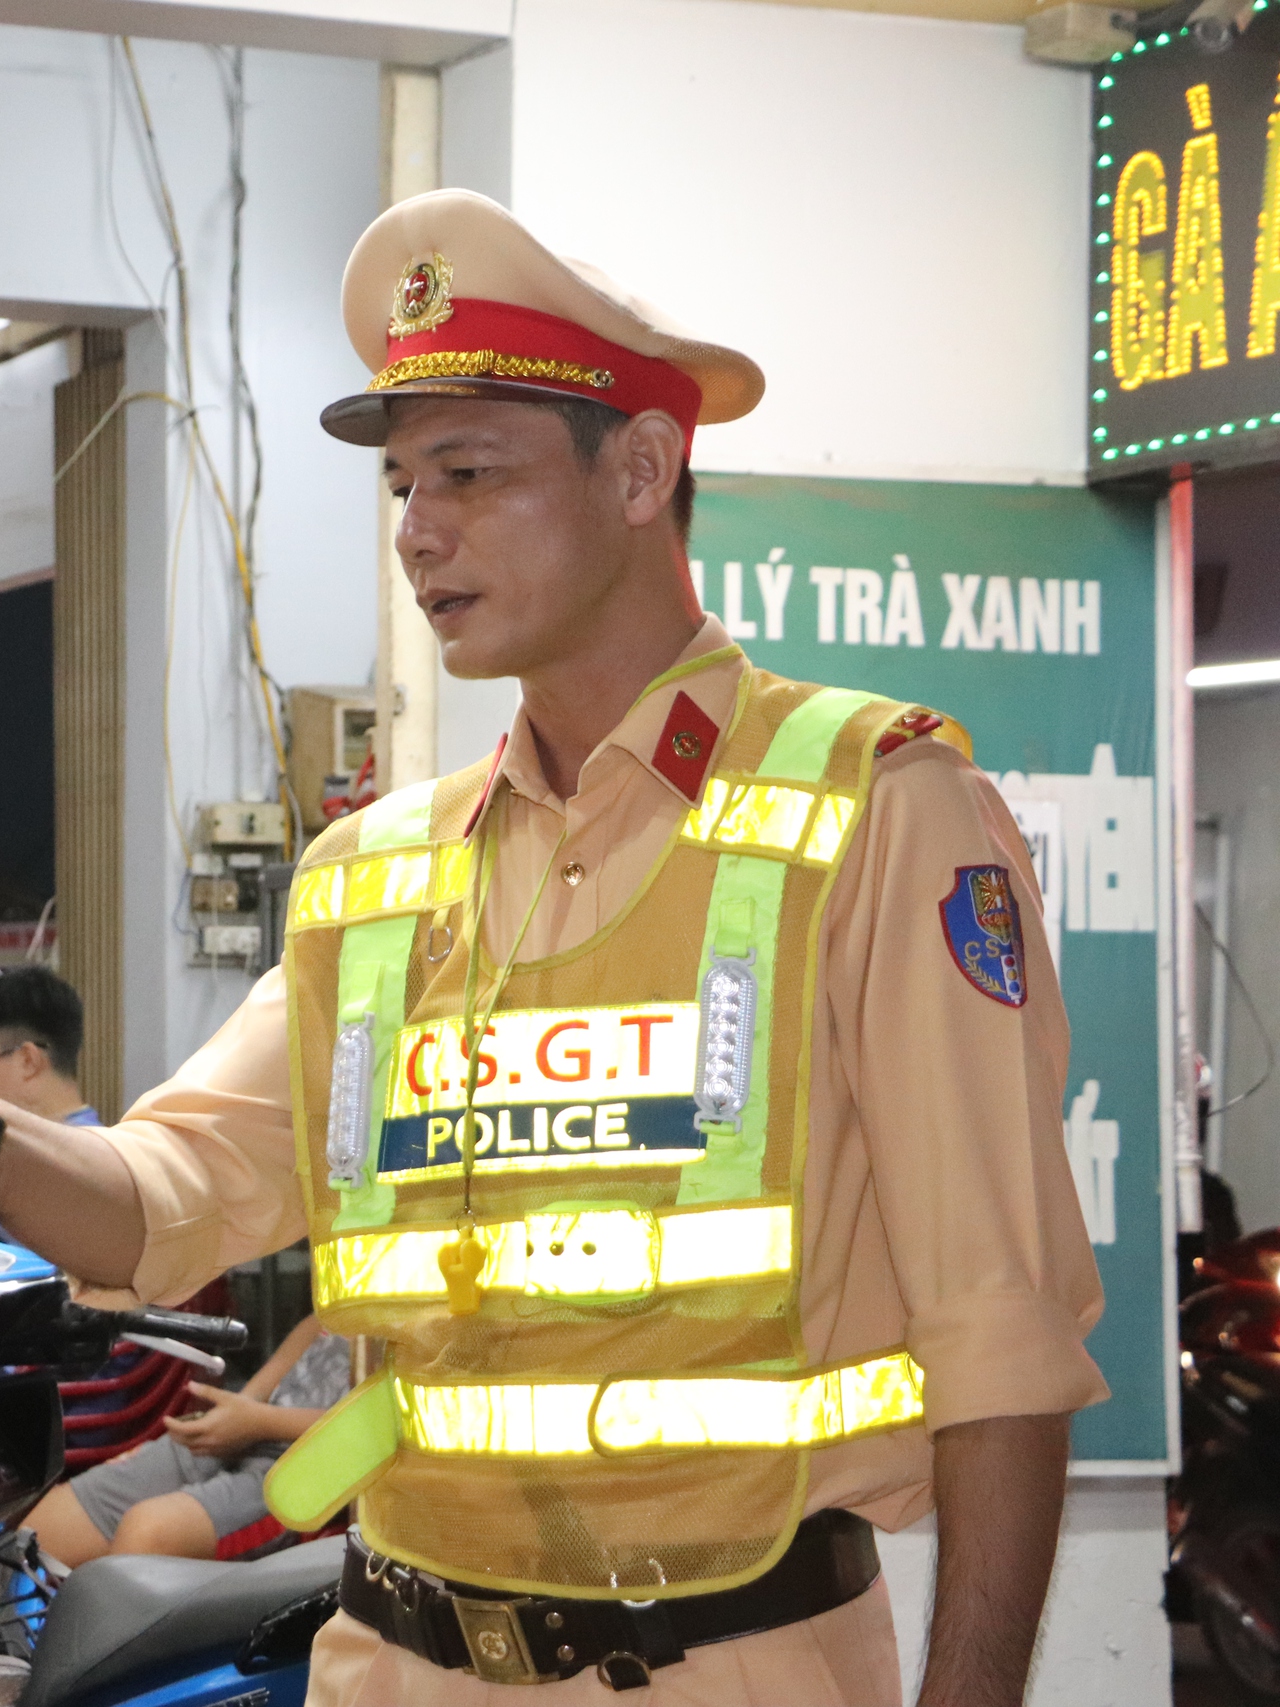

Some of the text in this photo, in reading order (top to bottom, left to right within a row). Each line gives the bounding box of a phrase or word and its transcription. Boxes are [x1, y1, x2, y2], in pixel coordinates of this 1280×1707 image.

[1112, 83, 1228, 390] GÀ
[724, 547, 794, 641] LÝ
[809, 554, 926, 647] TRÀ
[940, 572, 1102, 655] XANH
[406, 1015, 674, 1097] C.S.G.T
[427, 1102, 631, 1159] POLICE
